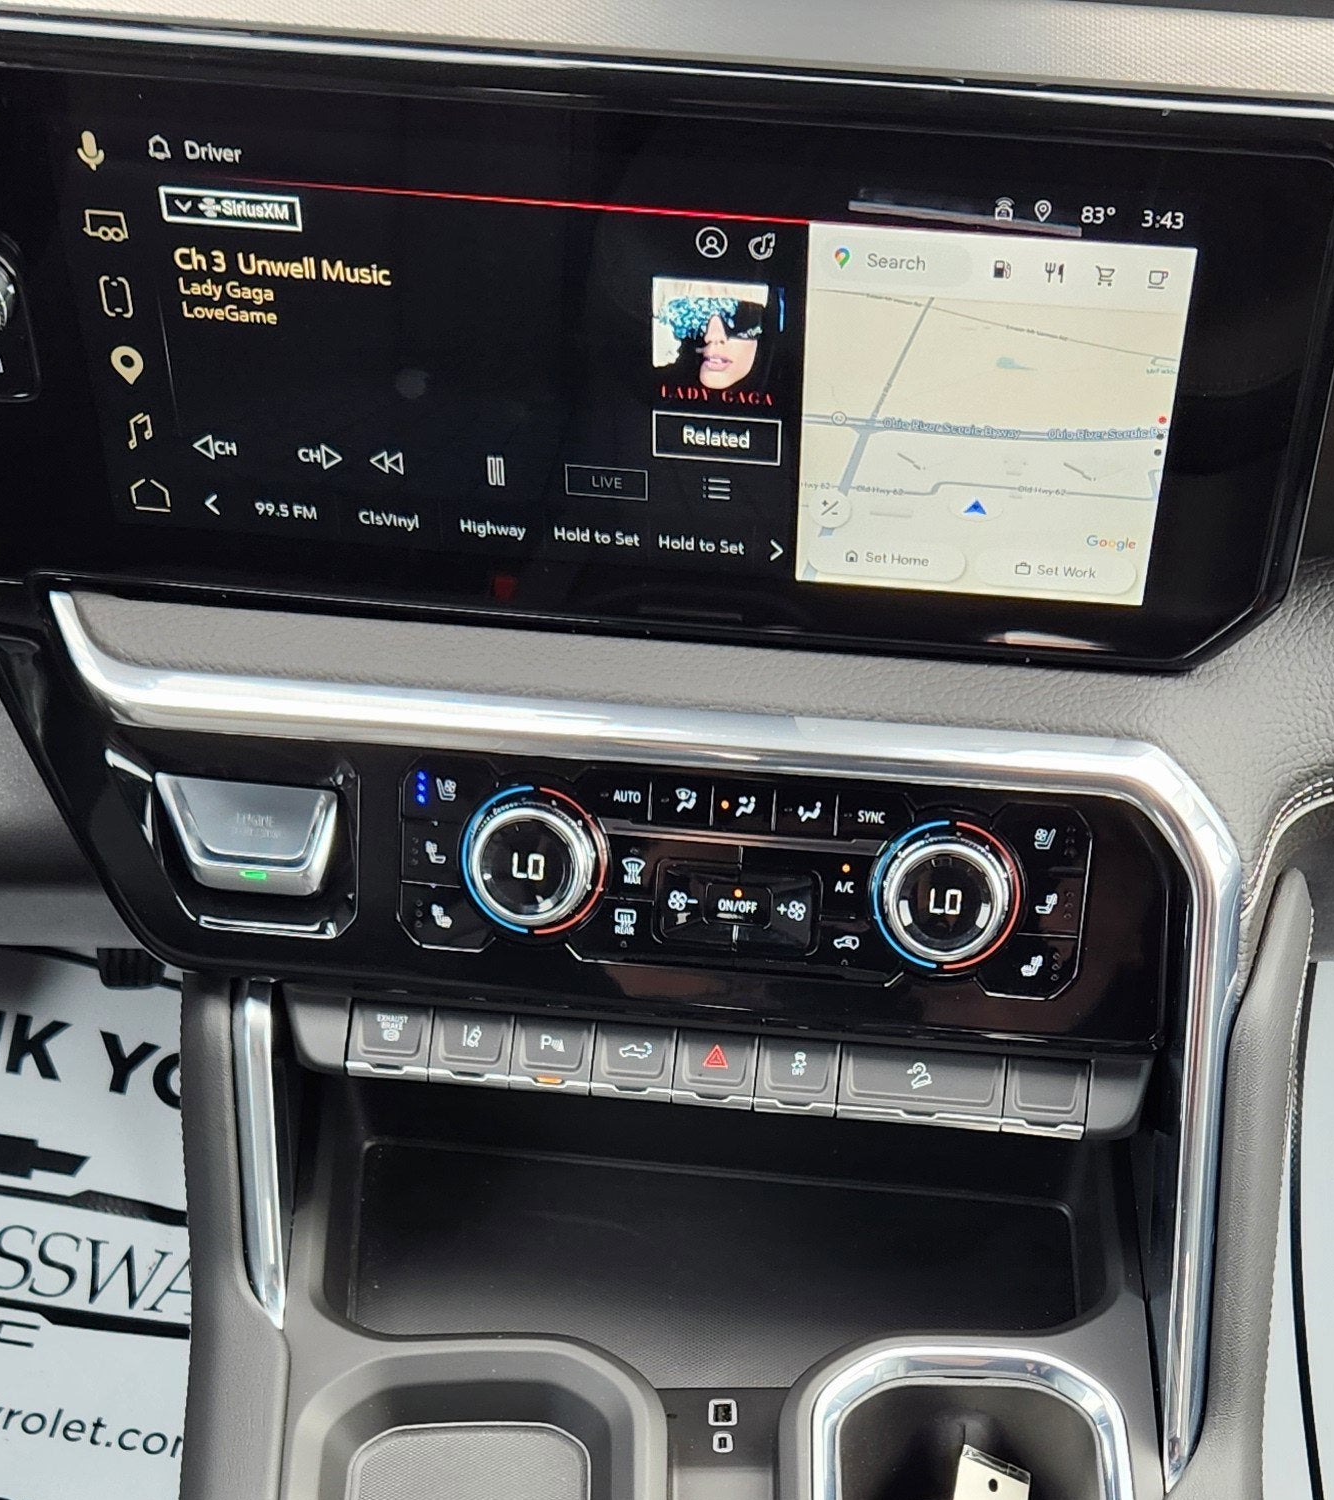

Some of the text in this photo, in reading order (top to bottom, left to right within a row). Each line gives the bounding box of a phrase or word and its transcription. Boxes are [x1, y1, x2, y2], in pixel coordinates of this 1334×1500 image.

[184, 140, 242, 165] Driver
[220, 199, 290, 221] SiriusXM
[1081, 206, 1116, 226] 83°
[1141, 208, 1185, 231] 3:43
[174, 247, 393, 287] Ch 3 Unwell Music
[866, 252, 927, 274] Search
[178, 276, 275, 304] Lady Gaga
[182, 301, 278, 326] LoveGame
[660, 384, 774, 407] LADY GAGA
[681, 425, 750, 450] Related
[213, 439, 238, 457] CH
[297, 445, 322, 464] CH
[591, 474, 624, 491] LIVE
[254, 501, 318, 520] 99.5 FM
[459, 518, 527, 542] Highway
[553, 526, 640, 548] Hold to Set
[657, 533, 745, 556] Hold to Set
[1085, 533, 1137, 552] Google
[864, 550, 930, 568] Set Home
[1036, 562, 1097, 580] Set Work
[613, 788, 642, 805] AUTO
[856, 809, 885, 826] SYNC
[834, 878, 855, 895] A/C
[717, 898, 758, 916] ON/OFF
[376, 1013, 409, 1024] EXHAUST
[380, 1021, 404, 1031] BRAKE
